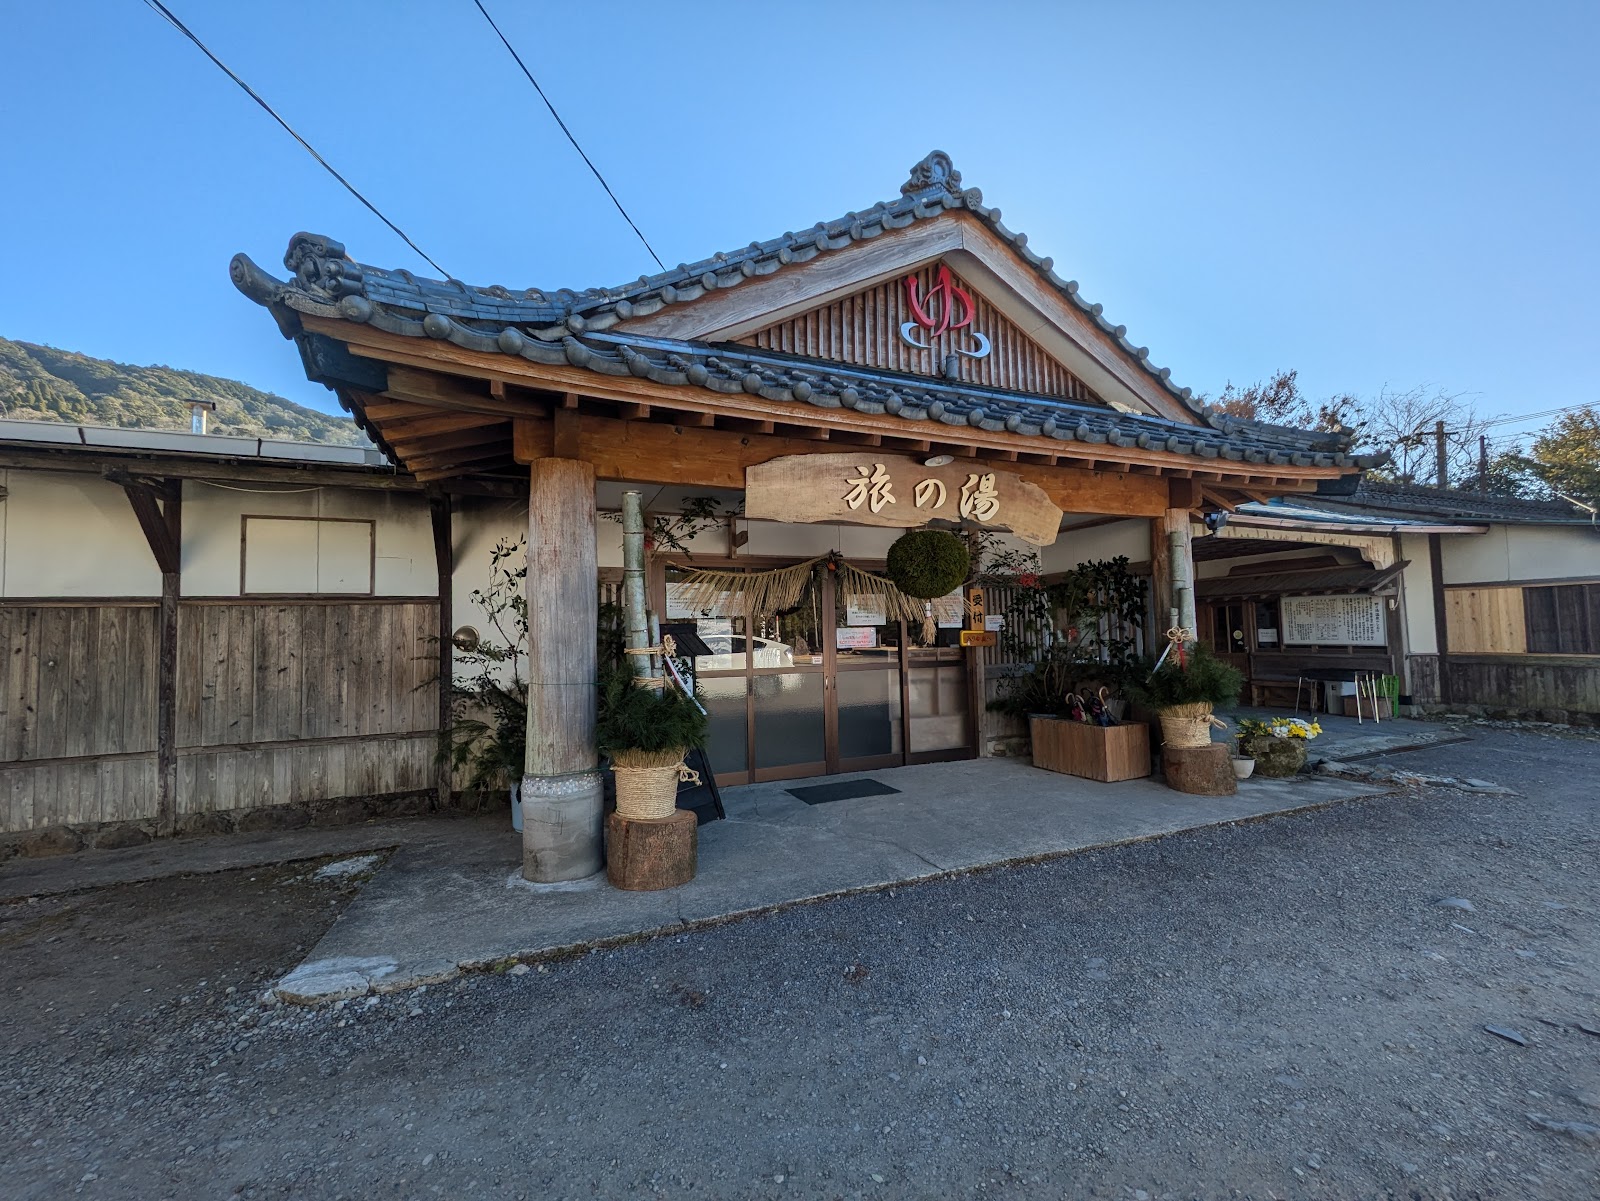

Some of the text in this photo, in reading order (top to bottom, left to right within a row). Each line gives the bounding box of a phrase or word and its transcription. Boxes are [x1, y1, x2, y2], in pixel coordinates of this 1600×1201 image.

[843, 463, 1001, 522] 旅の湯
[972, 594, 983, 624] 受付
